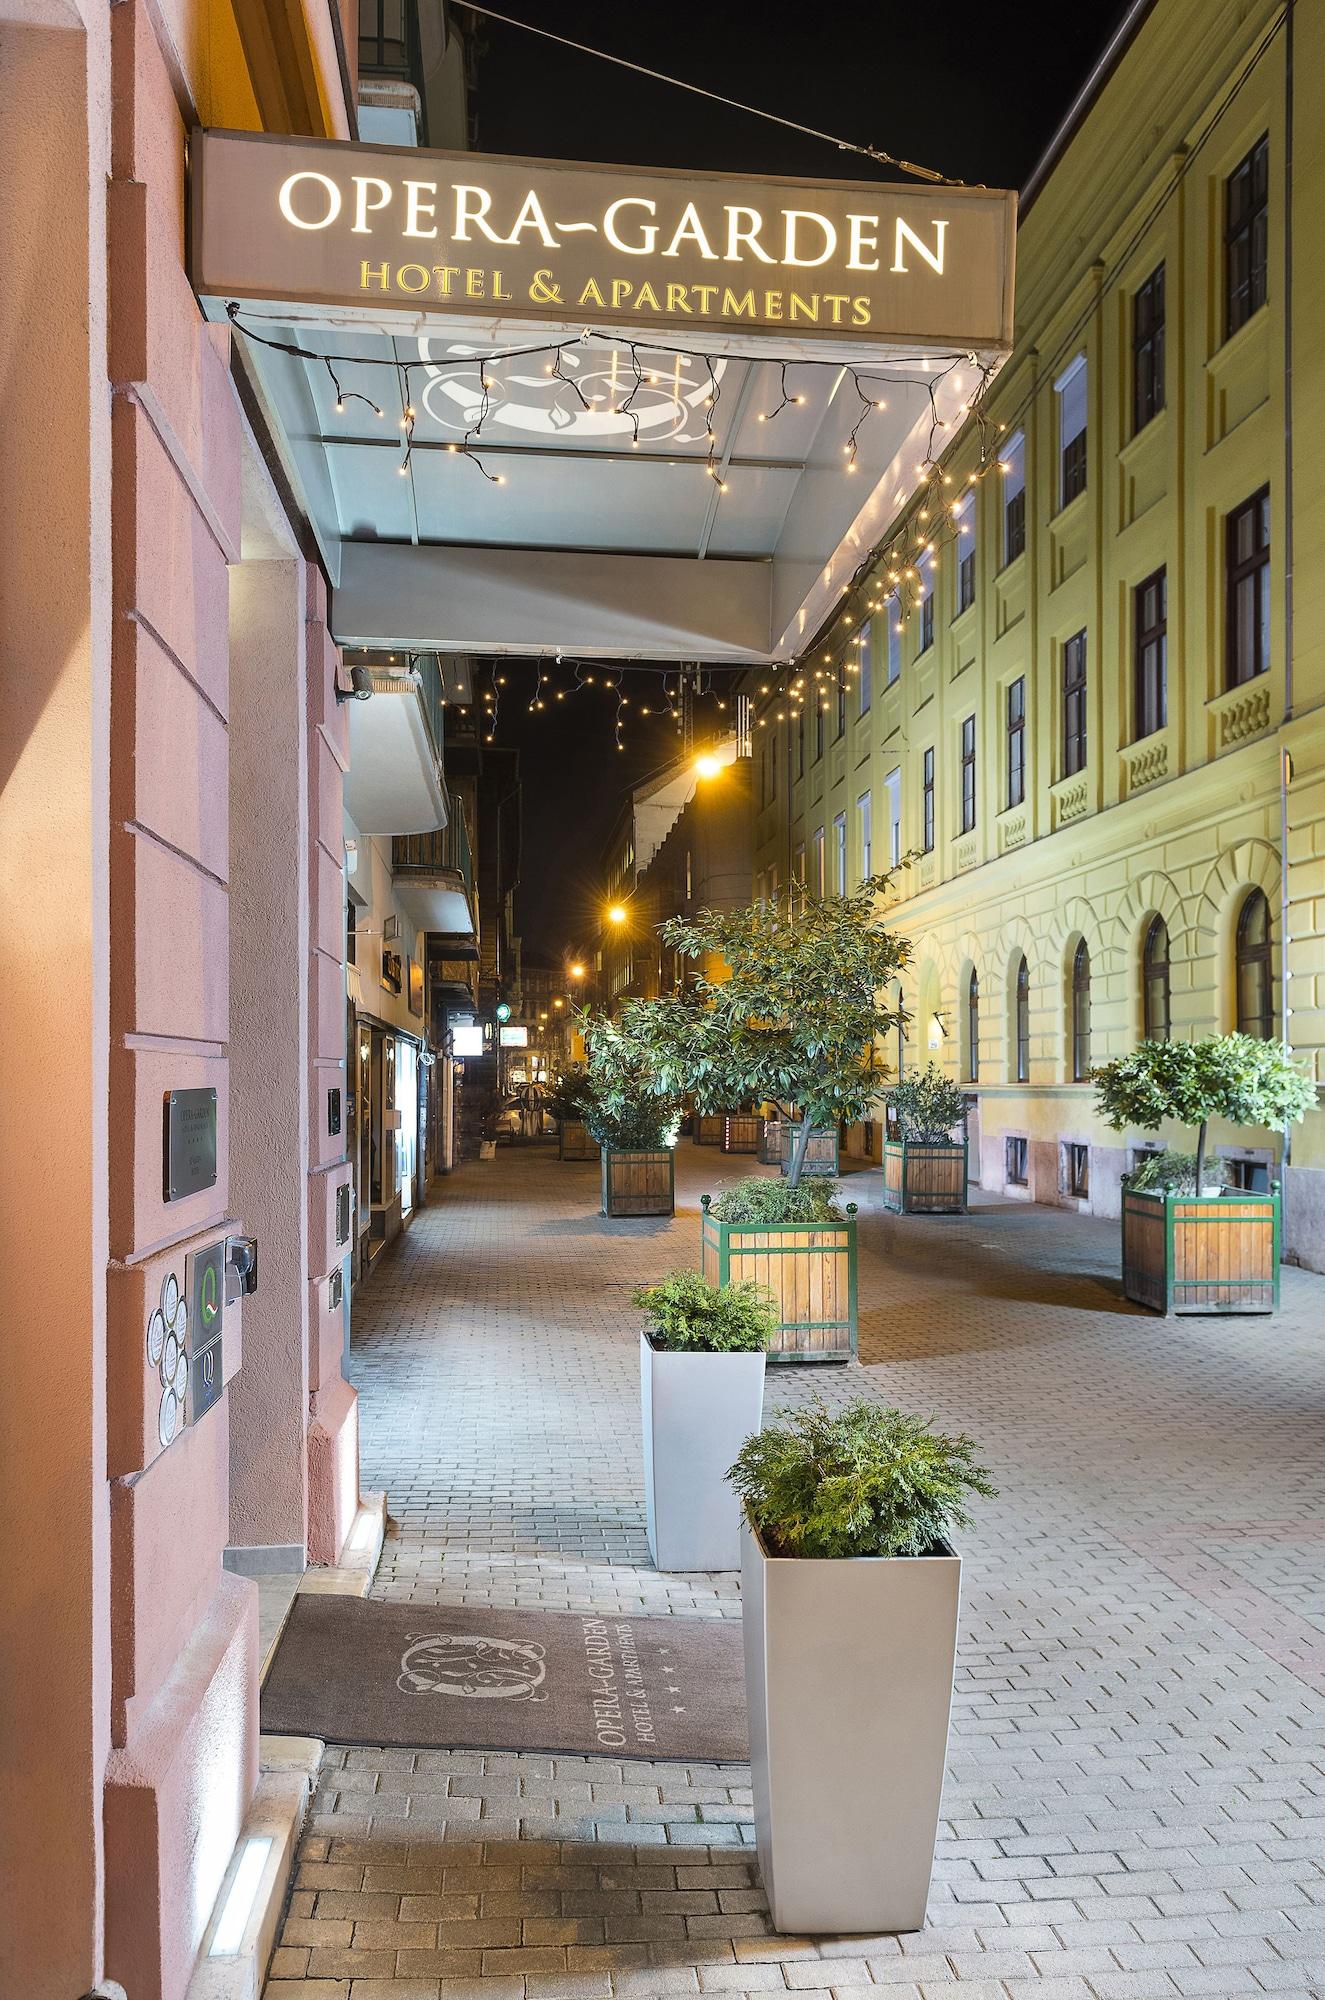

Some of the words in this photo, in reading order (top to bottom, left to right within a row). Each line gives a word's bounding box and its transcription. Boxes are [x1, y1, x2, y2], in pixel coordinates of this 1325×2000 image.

[359, 260, 512, 300] HOTEL
[528, 269, 566, 304] &
[577, 277, 872, 326] APARTMENTS
[615, 1624, 643, 1687] APARTMENTS
[625, 1689, 647, 1699] &
[631, 1701, 656, 1743] HOTEL
